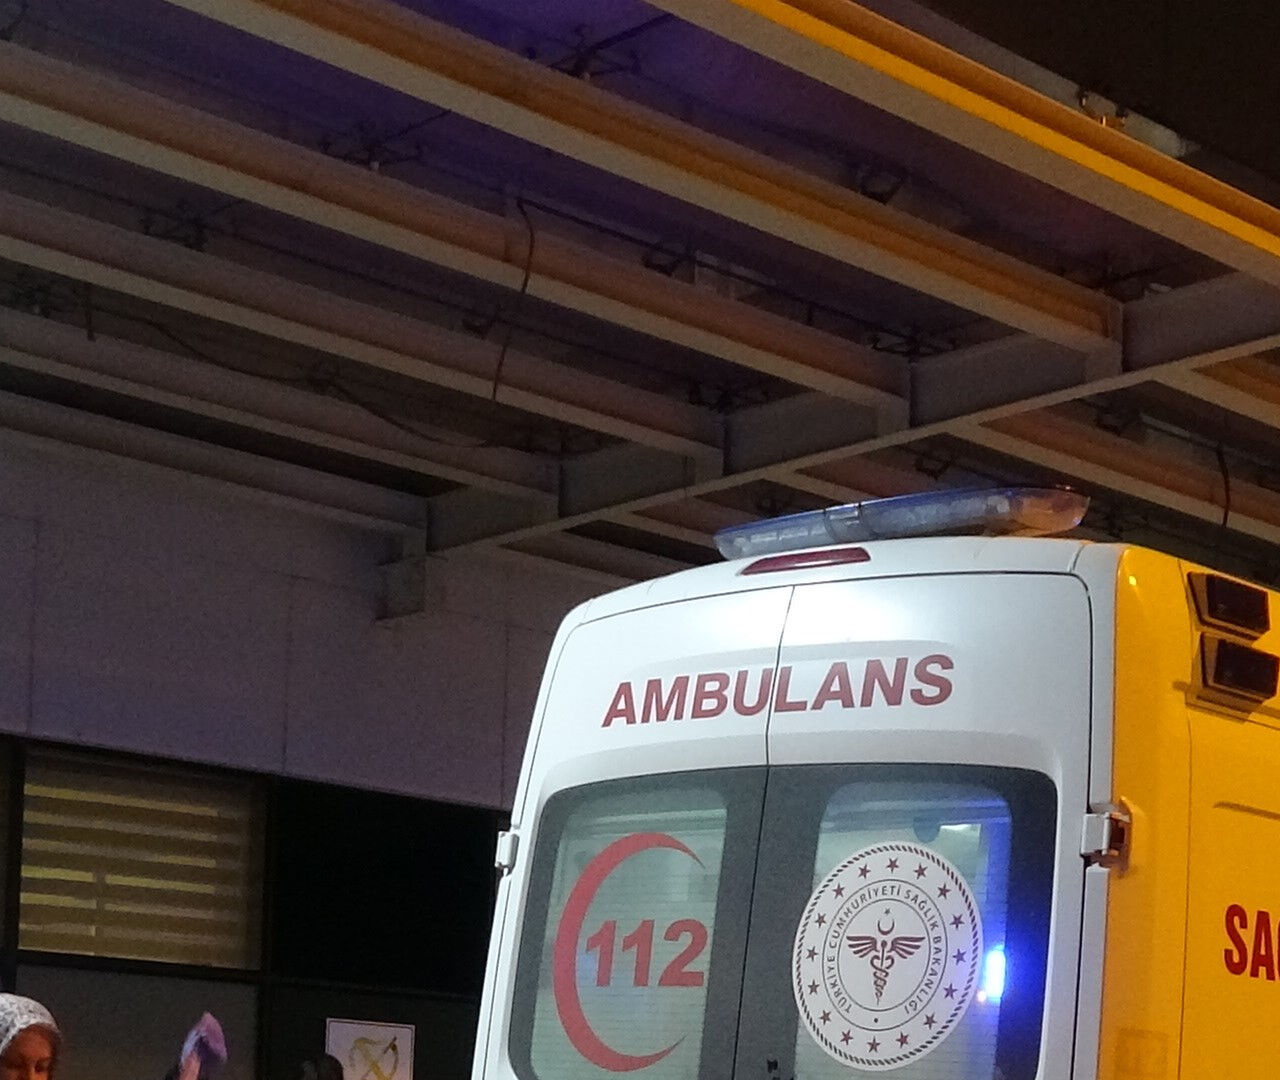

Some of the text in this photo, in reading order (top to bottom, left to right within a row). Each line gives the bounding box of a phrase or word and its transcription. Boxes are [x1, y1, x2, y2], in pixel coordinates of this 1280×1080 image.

[601, 654, 954, 728] AMBULANS
[585, 919, 709, 988] 112
[827, 884, 942, 1014] TÜRKİYE CUMHURİYETİ SAĞLIK BAKANLIĞI
